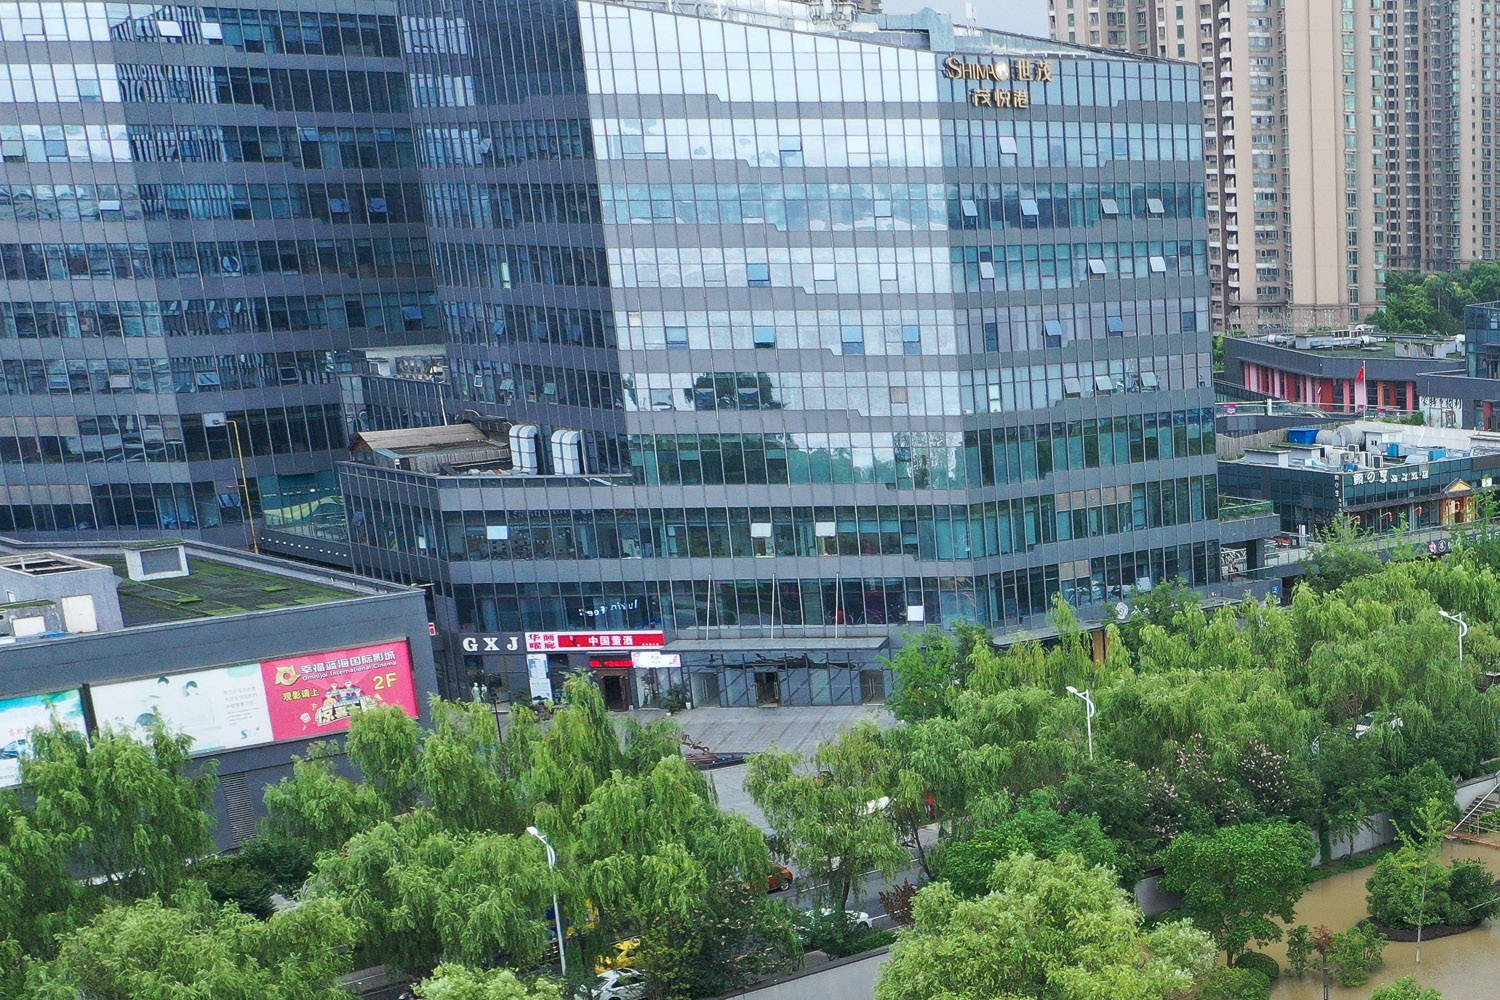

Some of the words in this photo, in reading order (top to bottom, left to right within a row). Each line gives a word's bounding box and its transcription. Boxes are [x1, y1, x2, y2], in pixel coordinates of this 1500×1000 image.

[1017, 58, 1053, 82] 世茂
[300, 650, 396, 674] 幸福蓝海国际影城
[373, 672, 398, 690] 2F
[282, 688, 320, 702] 观影请上
